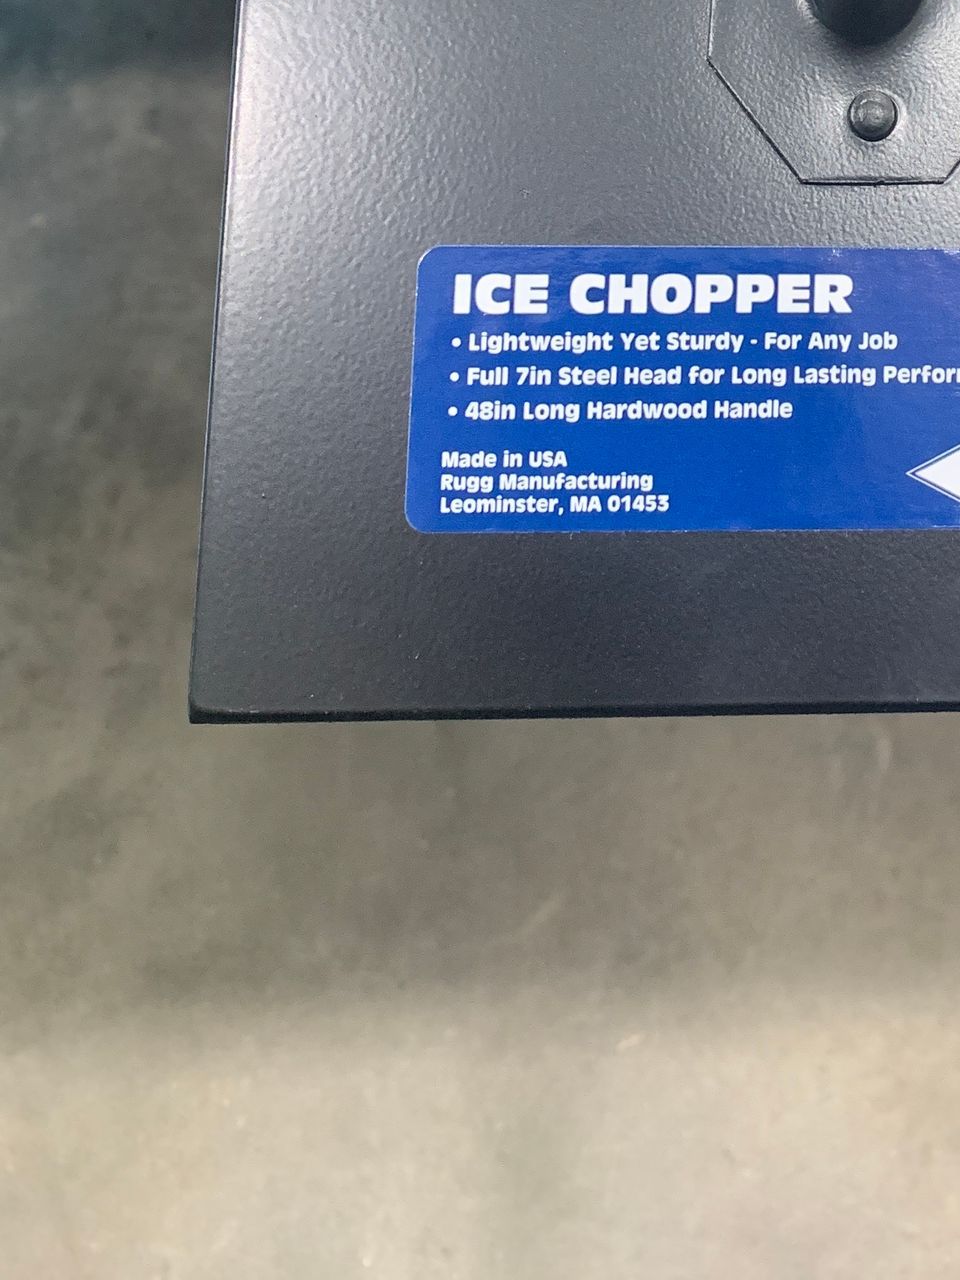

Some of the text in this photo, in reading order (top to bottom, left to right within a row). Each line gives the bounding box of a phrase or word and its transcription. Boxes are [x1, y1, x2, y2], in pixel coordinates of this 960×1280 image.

[452, 273, 854, 315] ICE CHOPPER
[469, 332, 613, 353] Lightweight
[620, 332, 660, 351] Yet
[666, 332, 744, 352] Sturdy
[764, 332, 802, 350] For
[808, 332, 851, 352] Any
[858, 332, 898, 350] Job
[467, 366, 508, 385] Full
[516, 366, 551, 385] 7in
[558, 366, 617, 385] Steel
[623, 366, 683, 385] Head
[688, 366, 725, 384] for
[731, 366, 787, 387] Long
[794, 365, 877, 386] Lasting
[464, 400, 793, 422] 48in Long Hardwood Handle
[441, 450, 568, 468] Made in USA
[440, 472, 654, 493] Rugg Manufacturing
[440, 494, 670, 516] Leominster, MA 01453
